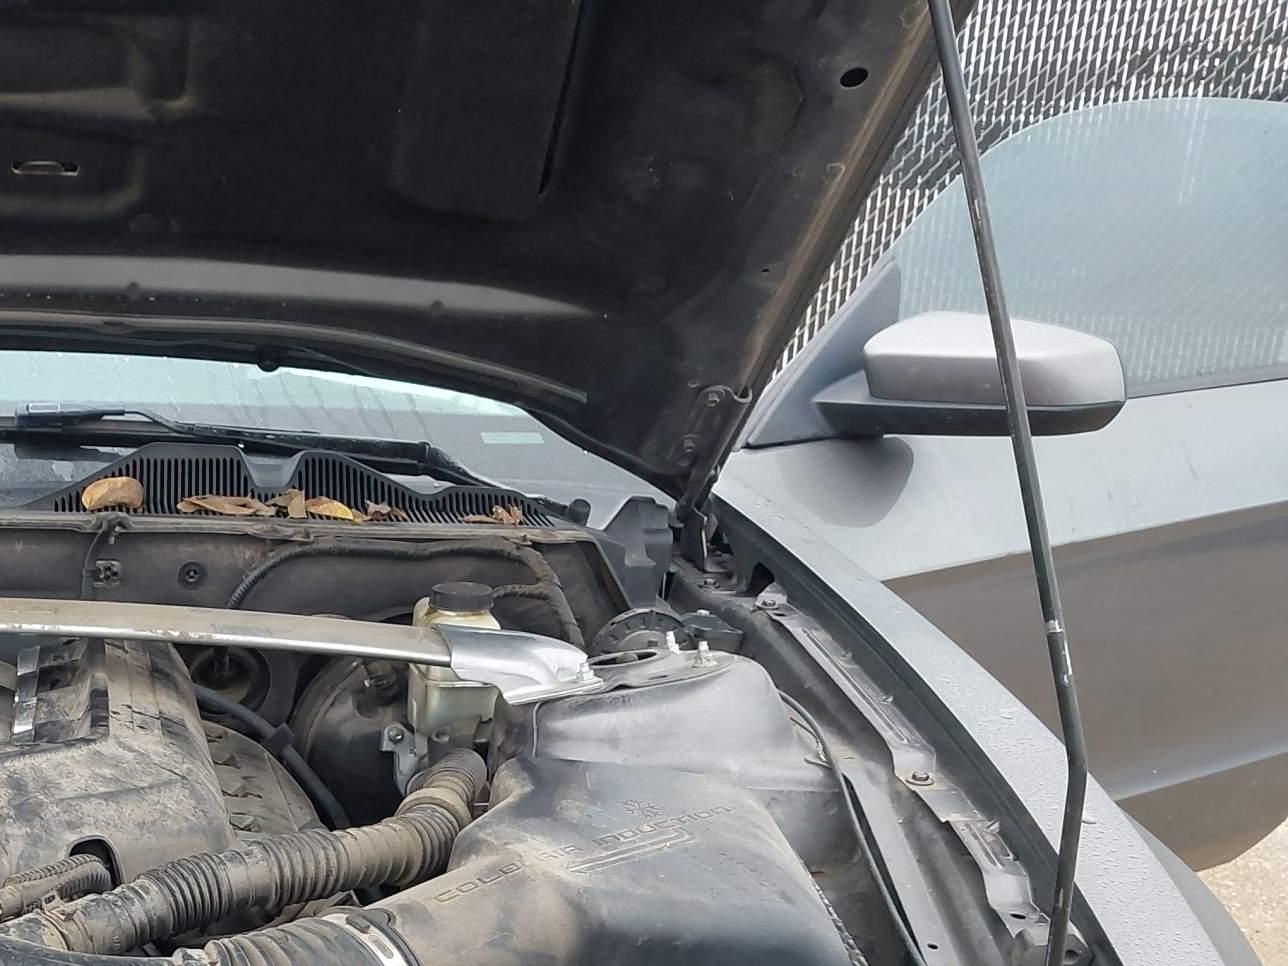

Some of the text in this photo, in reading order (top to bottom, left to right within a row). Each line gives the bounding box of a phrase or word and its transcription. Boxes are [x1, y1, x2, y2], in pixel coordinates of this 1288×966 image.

[432, 805, 735, 904] COLD AIR INDUCTION
